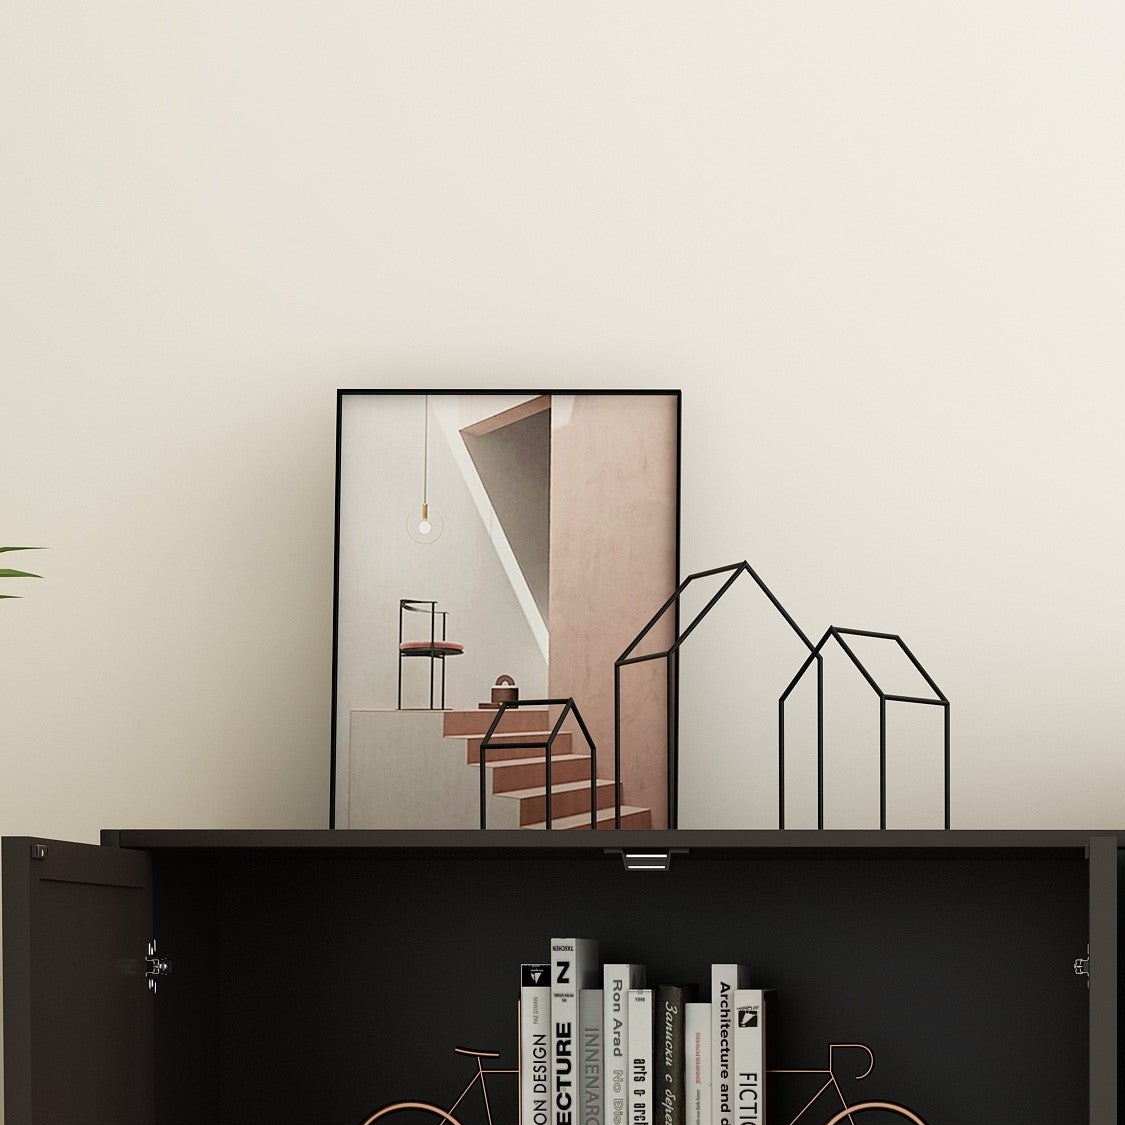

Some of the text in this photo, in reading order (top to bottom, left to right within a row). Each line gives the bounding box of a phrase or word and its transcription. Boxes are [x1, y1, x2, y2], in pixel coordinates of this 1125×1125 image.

[612, 979, 623, 1057] Ron Arad
[664, 1001, 678, 1067] Записки
[719, 981, 731, 1079] Architecture
[533, 1034, 547, 1093] DESIGN
[612, 1069, 624, 1093] No
[633, 1058, 647, 1082] arts
[664, 1074, 673, 1083] с
[719, 1084, 731, 1113] and
